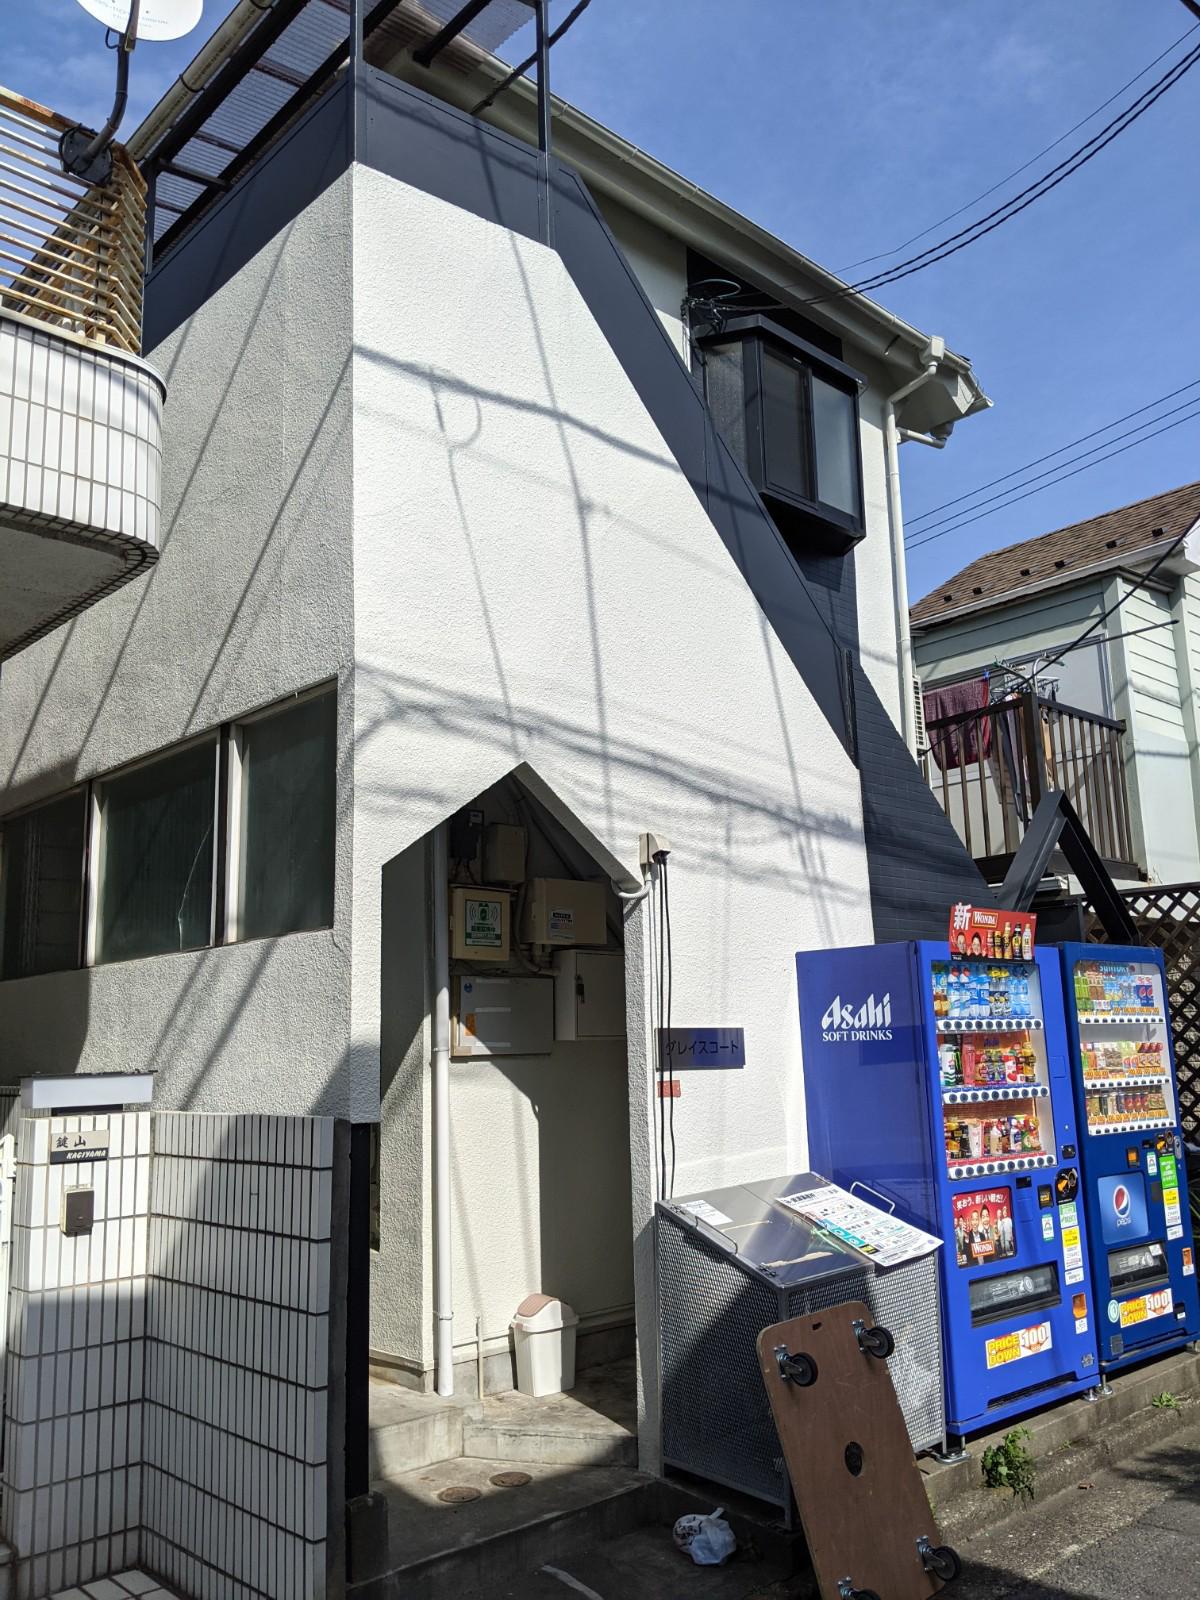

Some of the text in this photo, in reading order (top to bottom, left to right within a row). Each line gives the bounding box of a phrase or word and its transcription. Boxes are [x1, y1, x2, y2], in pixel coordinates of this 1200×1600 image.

[953, 902, 972, 930] 新
[974, 911, 996, 924] WONDA
[821, 992, 892, 1030] Asahi
[822, 1030, 893, 1041] SOFT DRINKS
[665, 1040, 739, 1056] グレイスコート
[66, 1150, 106, 1160] KAGIYAMA
[973, 1243, 993, 1254] WONDA
[1120, 1298, 1146, 1313] PRICE
[1148, 1291, 1169, 1310] 100
[1121, 1309, 1147, 1326] DOWN
[988, 1333, 1019, 1352] PRICE
[1022, 1325, 1048, 1347] 100
[989, 1346, 1020, 1367] DOWN
